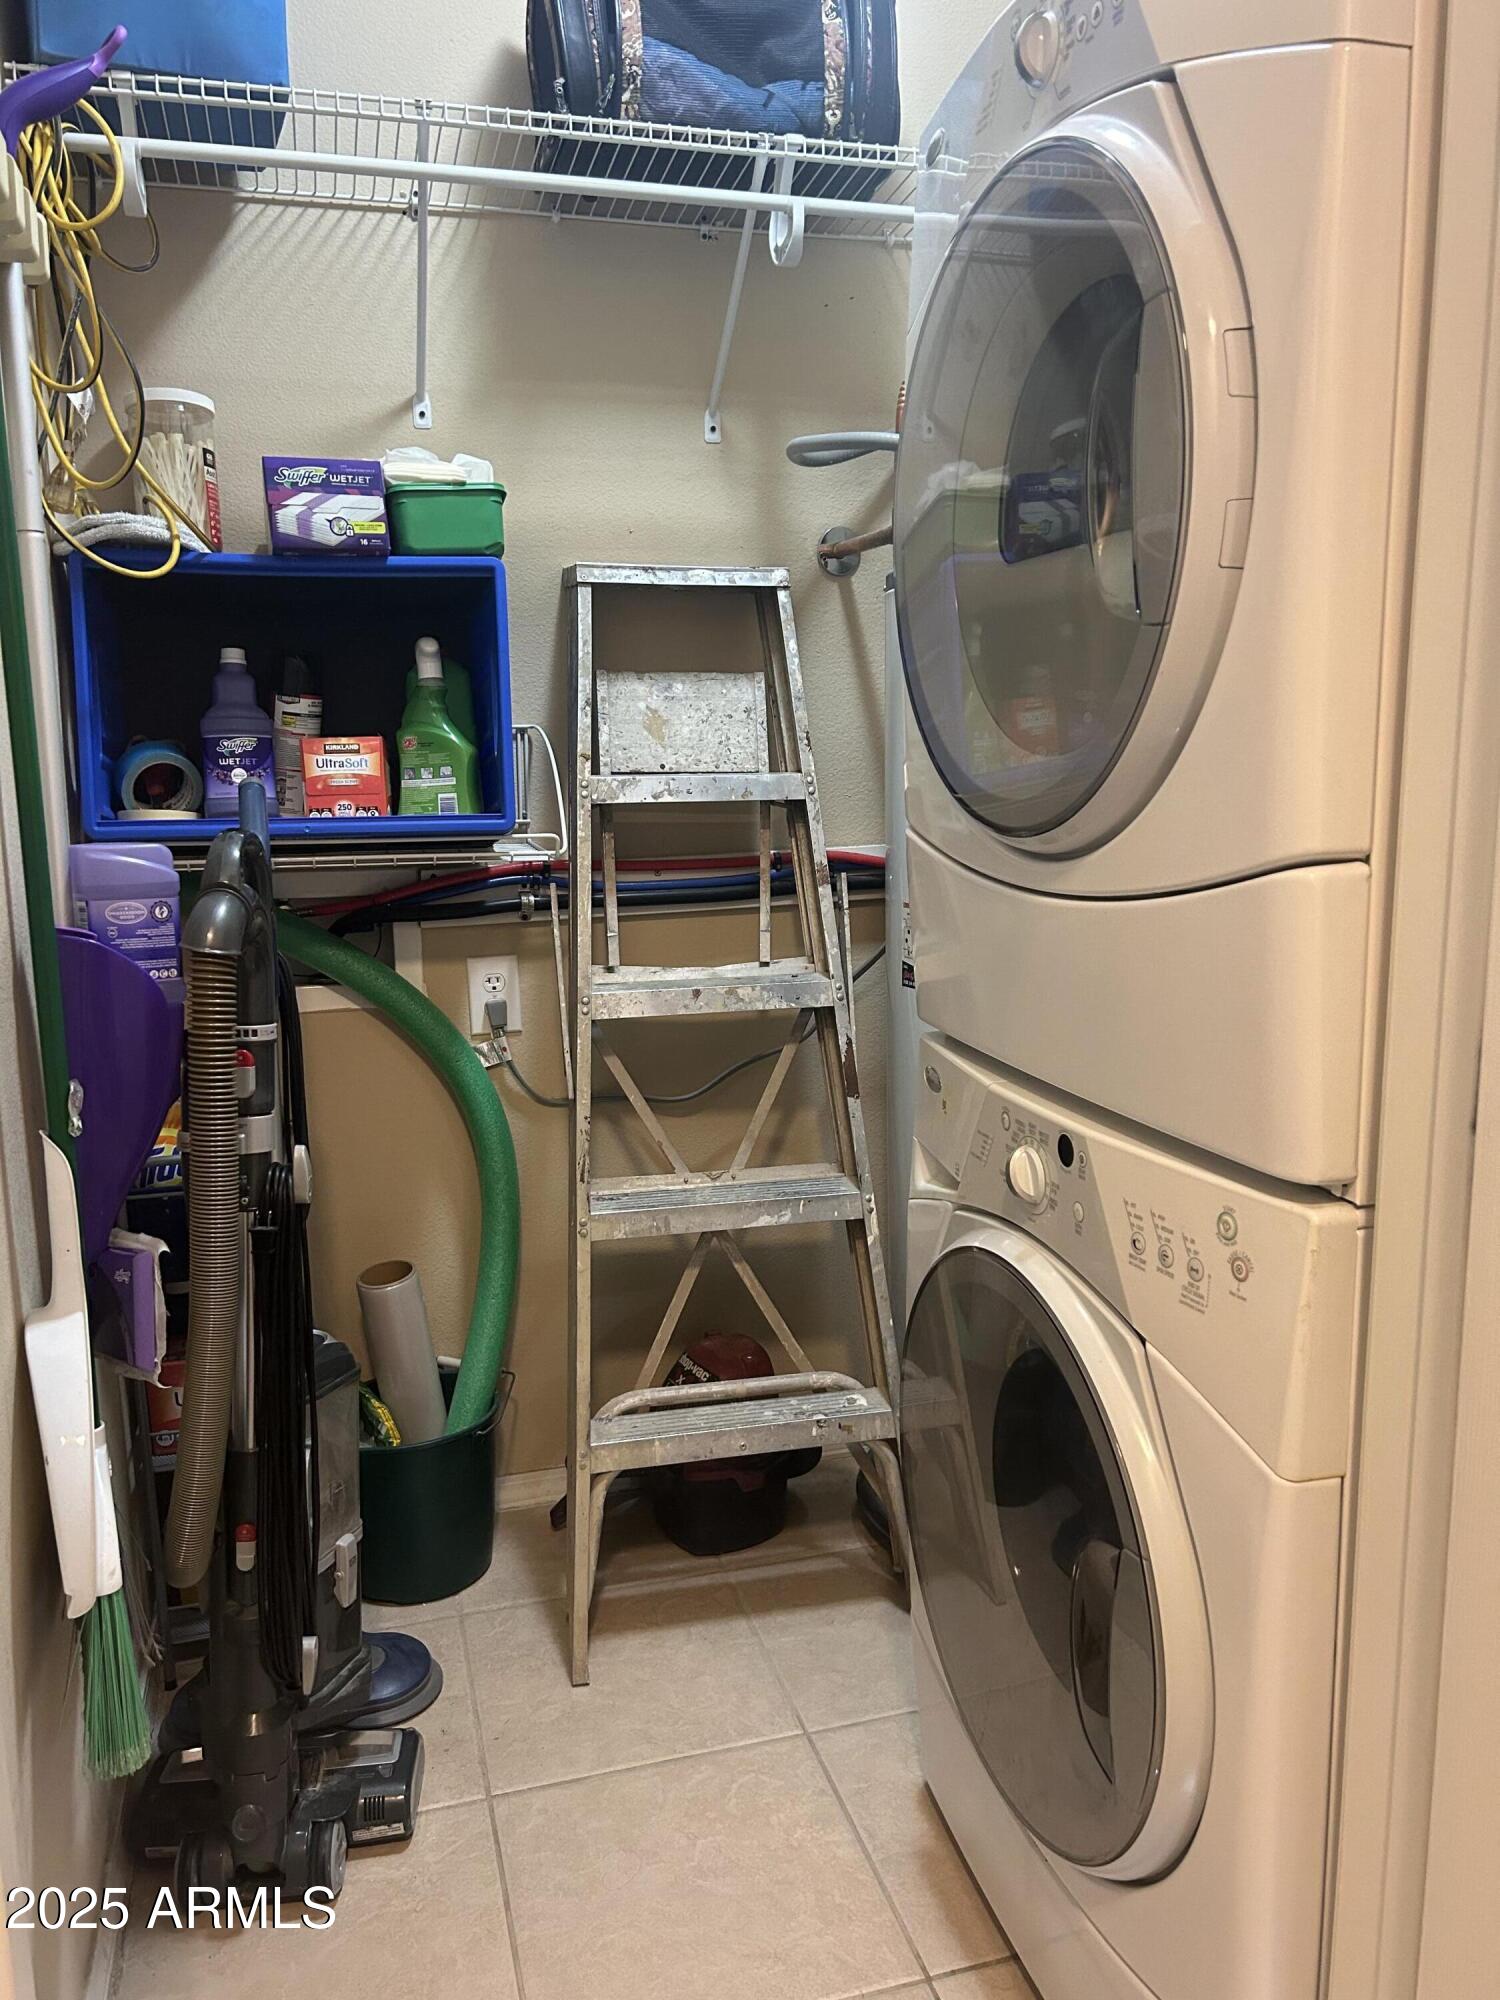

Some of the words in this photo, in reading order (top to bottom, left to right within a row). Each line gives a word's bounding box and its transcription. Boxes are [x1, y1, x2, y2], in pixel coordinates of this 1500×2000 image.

[274, 467, 326, 487] Swiffer
[329, 474, 371, 484] WETJET
[216, 738, 257, 754] Swiffer
[315, 758, 369, 769] UltraSoft
[337, 803, 352, 811] 250
